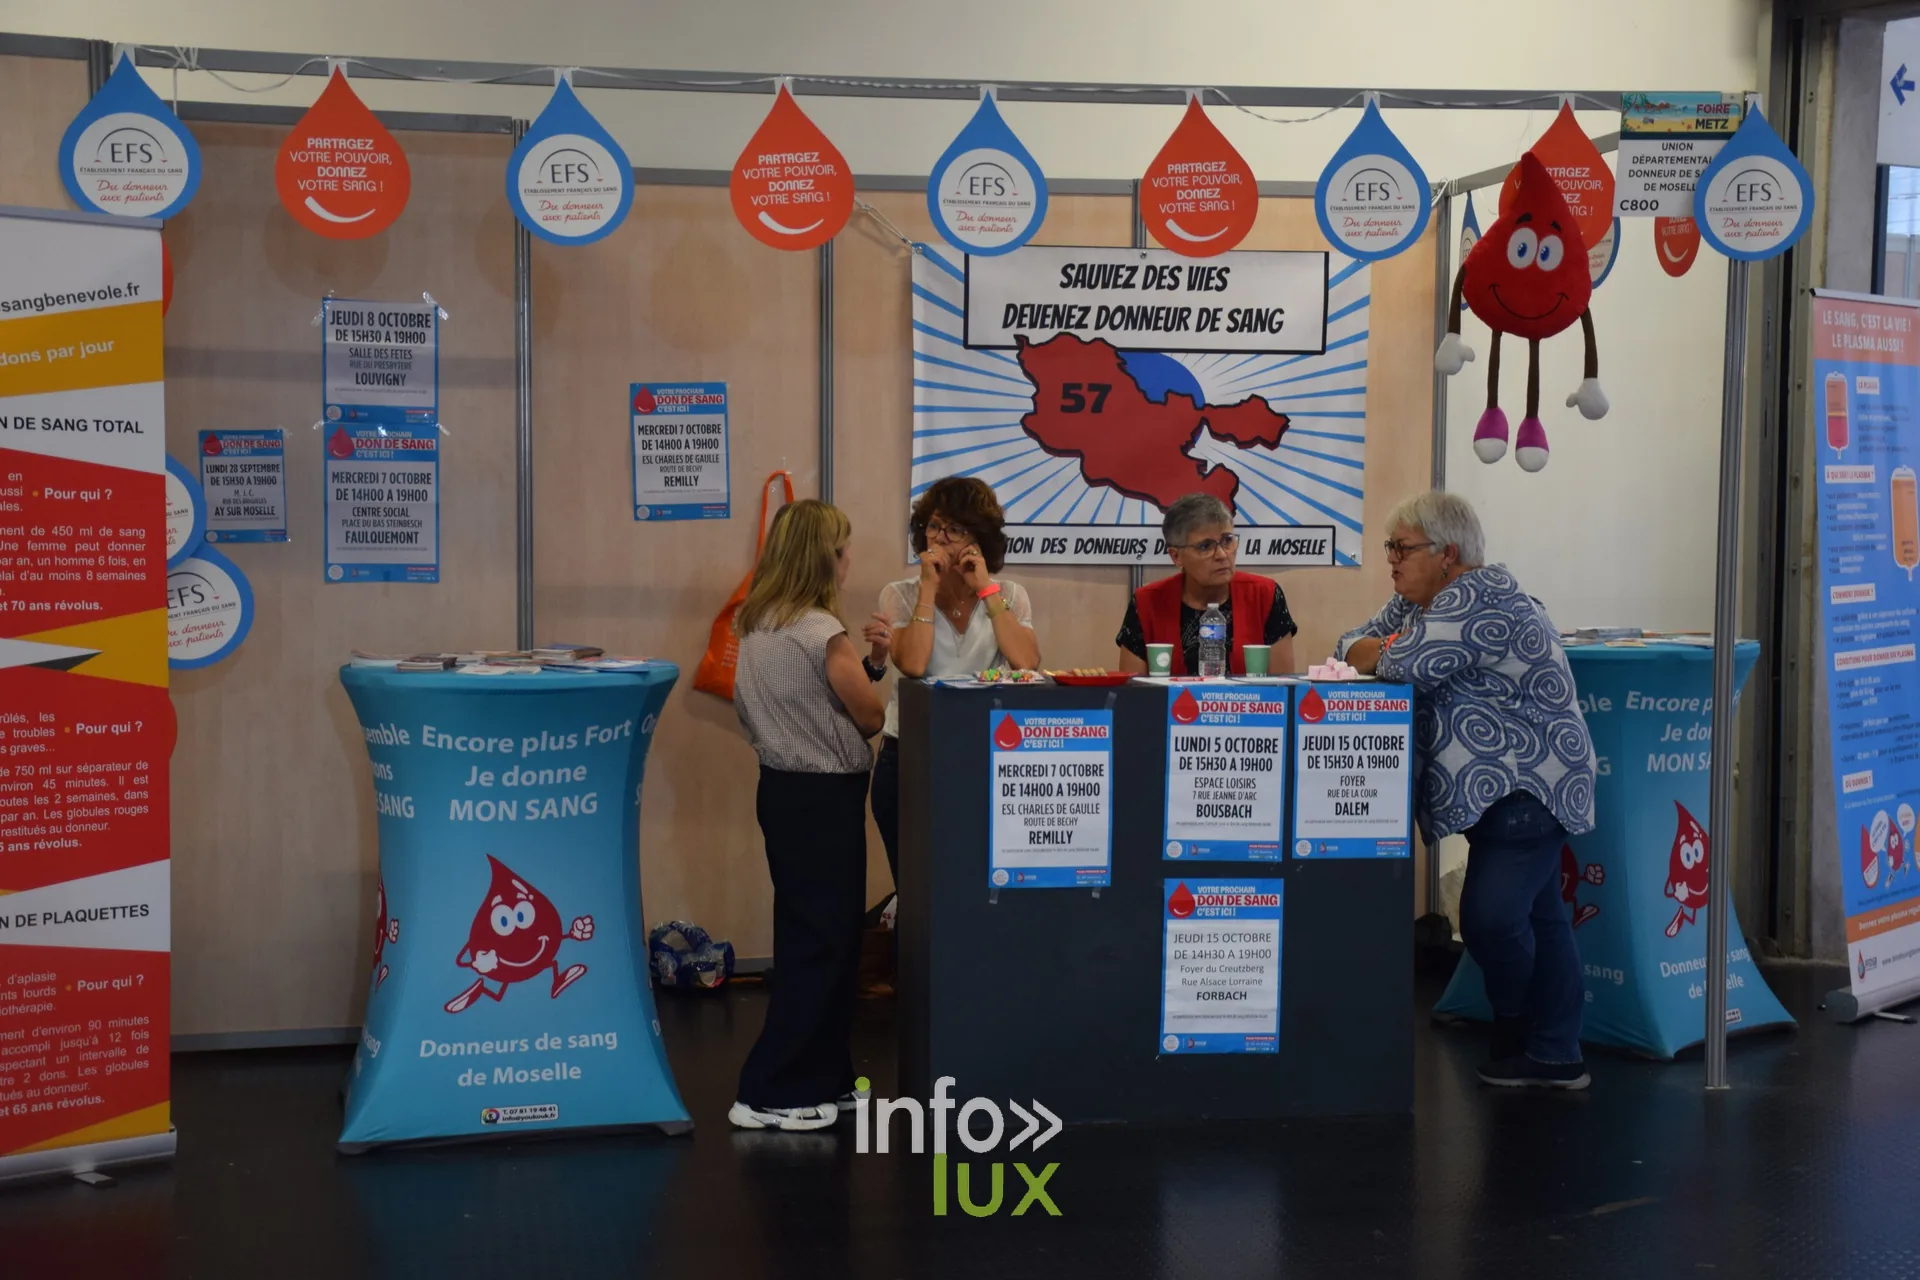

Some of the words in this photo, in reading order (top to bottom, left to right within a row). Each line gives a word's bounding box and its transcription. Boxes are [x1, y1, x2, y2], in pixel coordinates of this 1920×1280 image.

[1697, 104, 1730, 114] FOIRE
[1695, 119, 1728, 130] METZ
[307, 138, 374, 150] PARTAGEZ
[111, 143, 153, 163] EFS
[290, 151, 331, 163] VOTRE
[335, 152, 392, 165] POUVOIR,
[758, 152, 819, 164] PARTAGEZ
[317, 167, 366, 177] DONNEZ
[551, 163, 589, 183] EFS
[743, 166, 781, 179] VOTRE
[784, 164, 837, 177] POUVOIR,
[1167, 162, 1226, 174] PARTAGEZ
[1629, 170, 1676, 178] DONNEUR
[1679, 170, 1692, 178] DE
[96, 180, 118, 191] Du
[122, 181, 168, 190] donneur
[297, 180, 339, 192] VOTRE
[343, 180, 376, 191] SANG
[768, 179, 814, 191] DONNEZ
[970, 177, 1005, 196] EFS
[1356, 182, 1390, 201] EFS
[1644, 183, 1656, 191] DE
[1660, 183, 1697, 191] MOSELL
[124, 192, 164, 204] patients
[751, 194, 789, 206] VOTRE
[793, 192, 824, 205] SANG
[1737, 183, 1772, 202] EFS
[1620, 200, 1659, 210] C800
[1342, 216, 1360, 227] Du
[1364, 217, 1403, 227] donneur
[1365, 228, 1399, 240] patients
[1060, 264, 1138, 291] SAUVEZ
[1142, 265, 1182, 291] DES
[1187, 266, 1230, 292] VIES
[0, 282, 140, 312] sangbenevole.fr
[330, 311, 364, 326] JEUDI
[368, 312, 374, 326] 8
[378, 312, 431, 328] OCTOBRE
[1002, 303, 1091, 329] DEVENEZ
[1095, 305, 1191, 332] DONNEUR
[1196, 307, 1223, 332] DE
[1227, 308, 1284, 334] SANG
[1823, 310, 1832, 325] LE
[1834, 312, 1859, 329] SANG,
[1861, 315, 1881, 329] C'EST
[1884, 318, 1894, 329] LA
[1895, 318, 1907, 332] VIE
[1832, 333, 1841, 348] LE
[1843, 335, 1875, 350] PLASMA
[1877, 338, 1900, 352] AUSSI
[0, 350, 41, 366] dons
[47, 346, 74, 363] par
[80, 340, 114, 359] jour
[356, 372, 406, 386] LOUVIGNY
[1060, 383, 1112, 413] 57
[14, 416, 35, 430] DE
[42, 417, 87, 432] SANG
[93, 420, 144, 434] TOTAL
[638, 425, 677, 435] MERCREDI
[679, 425, 684, 434] 7
[686, 424, 721, 434] OCTOBRE
[356, 439, 382, 449] DON
[384, 439, 399, 449] DE
[401, 440, 434, 449] SANG
[206, 464, 228, 473] LUNDI
[230, 464, 238, 473] 28
[240, 464, 280, 473] SEPTEMBRE
[211, 477, 220, 486] DE
[223, 476, 244, 485] 15H30
[247, 476, 252, 485] A
[254, 476, 277, 485] 19H00
[332, 472, 379, 484] MERCREDI
[382, 473, 386, 484] 7
[390, 473, 432, 485] OCTOBRE
[664, 476, 699, 487] REMILLY
[44, 488, 76, 499] Pour
[80, 489, 100, 502] qui
[105, 489, 112, 499] ?
[215, 507, 225, 516] AY
[227, 506, 241, 516] SUR
[244, 506, 275, 516] MOSELLE
[31, 526, 45, 535] de
[52, 526, 73, 536] 450
[80, 526, 93, 536] ml
[99, 527, 113, 536] de
[119, 528, 145, 538] sang
[345, 531, 419, 544] FAULQUEMONT
[27, 542, 66, 550] femme
[75, 542, 100, 553] peut
[108, 542, 146, 550] donner
[1040, 538, 1068, 554] DES
[1074, 538, 1148, 555] DONNEURS
[1245, 539, 1261, 555] LA
[1267, 539, 1327, 555] MOSELLE
[1625, 690, 1700, 712] Encore
[76, 723, 107, 735] Pour
[111, 722, 131, 735] qui
[135, 721, 143, 732] ?
[1024, 726, 1050, 738] DON
[1054, 726, 1070, 737] DE
[1072, 726, 1107, 738] SANG
[1660, 723, 1682, 743] Je
[422, 724, 514, 753] Encore
[522, 730, 578, 758] plus
[585, 719, 632, 747] Fort
[1175, 736, 1210, 752] LUNDI
[1214, 737, 1221, 752] 5
[1225, 737, 1278, 754] OCTOBRE
[1302, 736, 1335, 751] JEUDI
[1339, 736, 1350, 751] 15
[1353, 735, 1405, 751] OCTOBRE
[1647, 753, 1694, 773] MON
[465, 765, 494, 787] Je
[502, 764, 587, 786] donne
[998, 764, 1048, 777] MERCREDI
[1051, 765, 1056, 777] 7
[1060, 764, 1104, 777] OCTOBRE
[450, 799, 517, 822] MON
[525, 792, 597, 821] SANG
[1196, 804, 1252, 818] BOUSBACH
[1335, 802, 1369, 816] DALEM
[1029, 830, 1073, 845] REMILLY
[15, 914, 37, 928] DE
[43, 904, 149, 925] PLAQUETTES
[1173, 934, 1203, 944] JEUDI
[1207, 933, 1219, 943] 15
[1222, 933, 1271, 943] OCTOBRE
[1584, 964, 1624, 986] sang
[1197, 991, 1247, 1001] FORBACH
[419, 1036, 529, 1058] Donneurs
[535, 1033, 562, 1051] de
[568, 1032, 618, 1050] sang
[457, 1069, 487, 1087] de
[493, 1062, 581, 1085] Moselle
